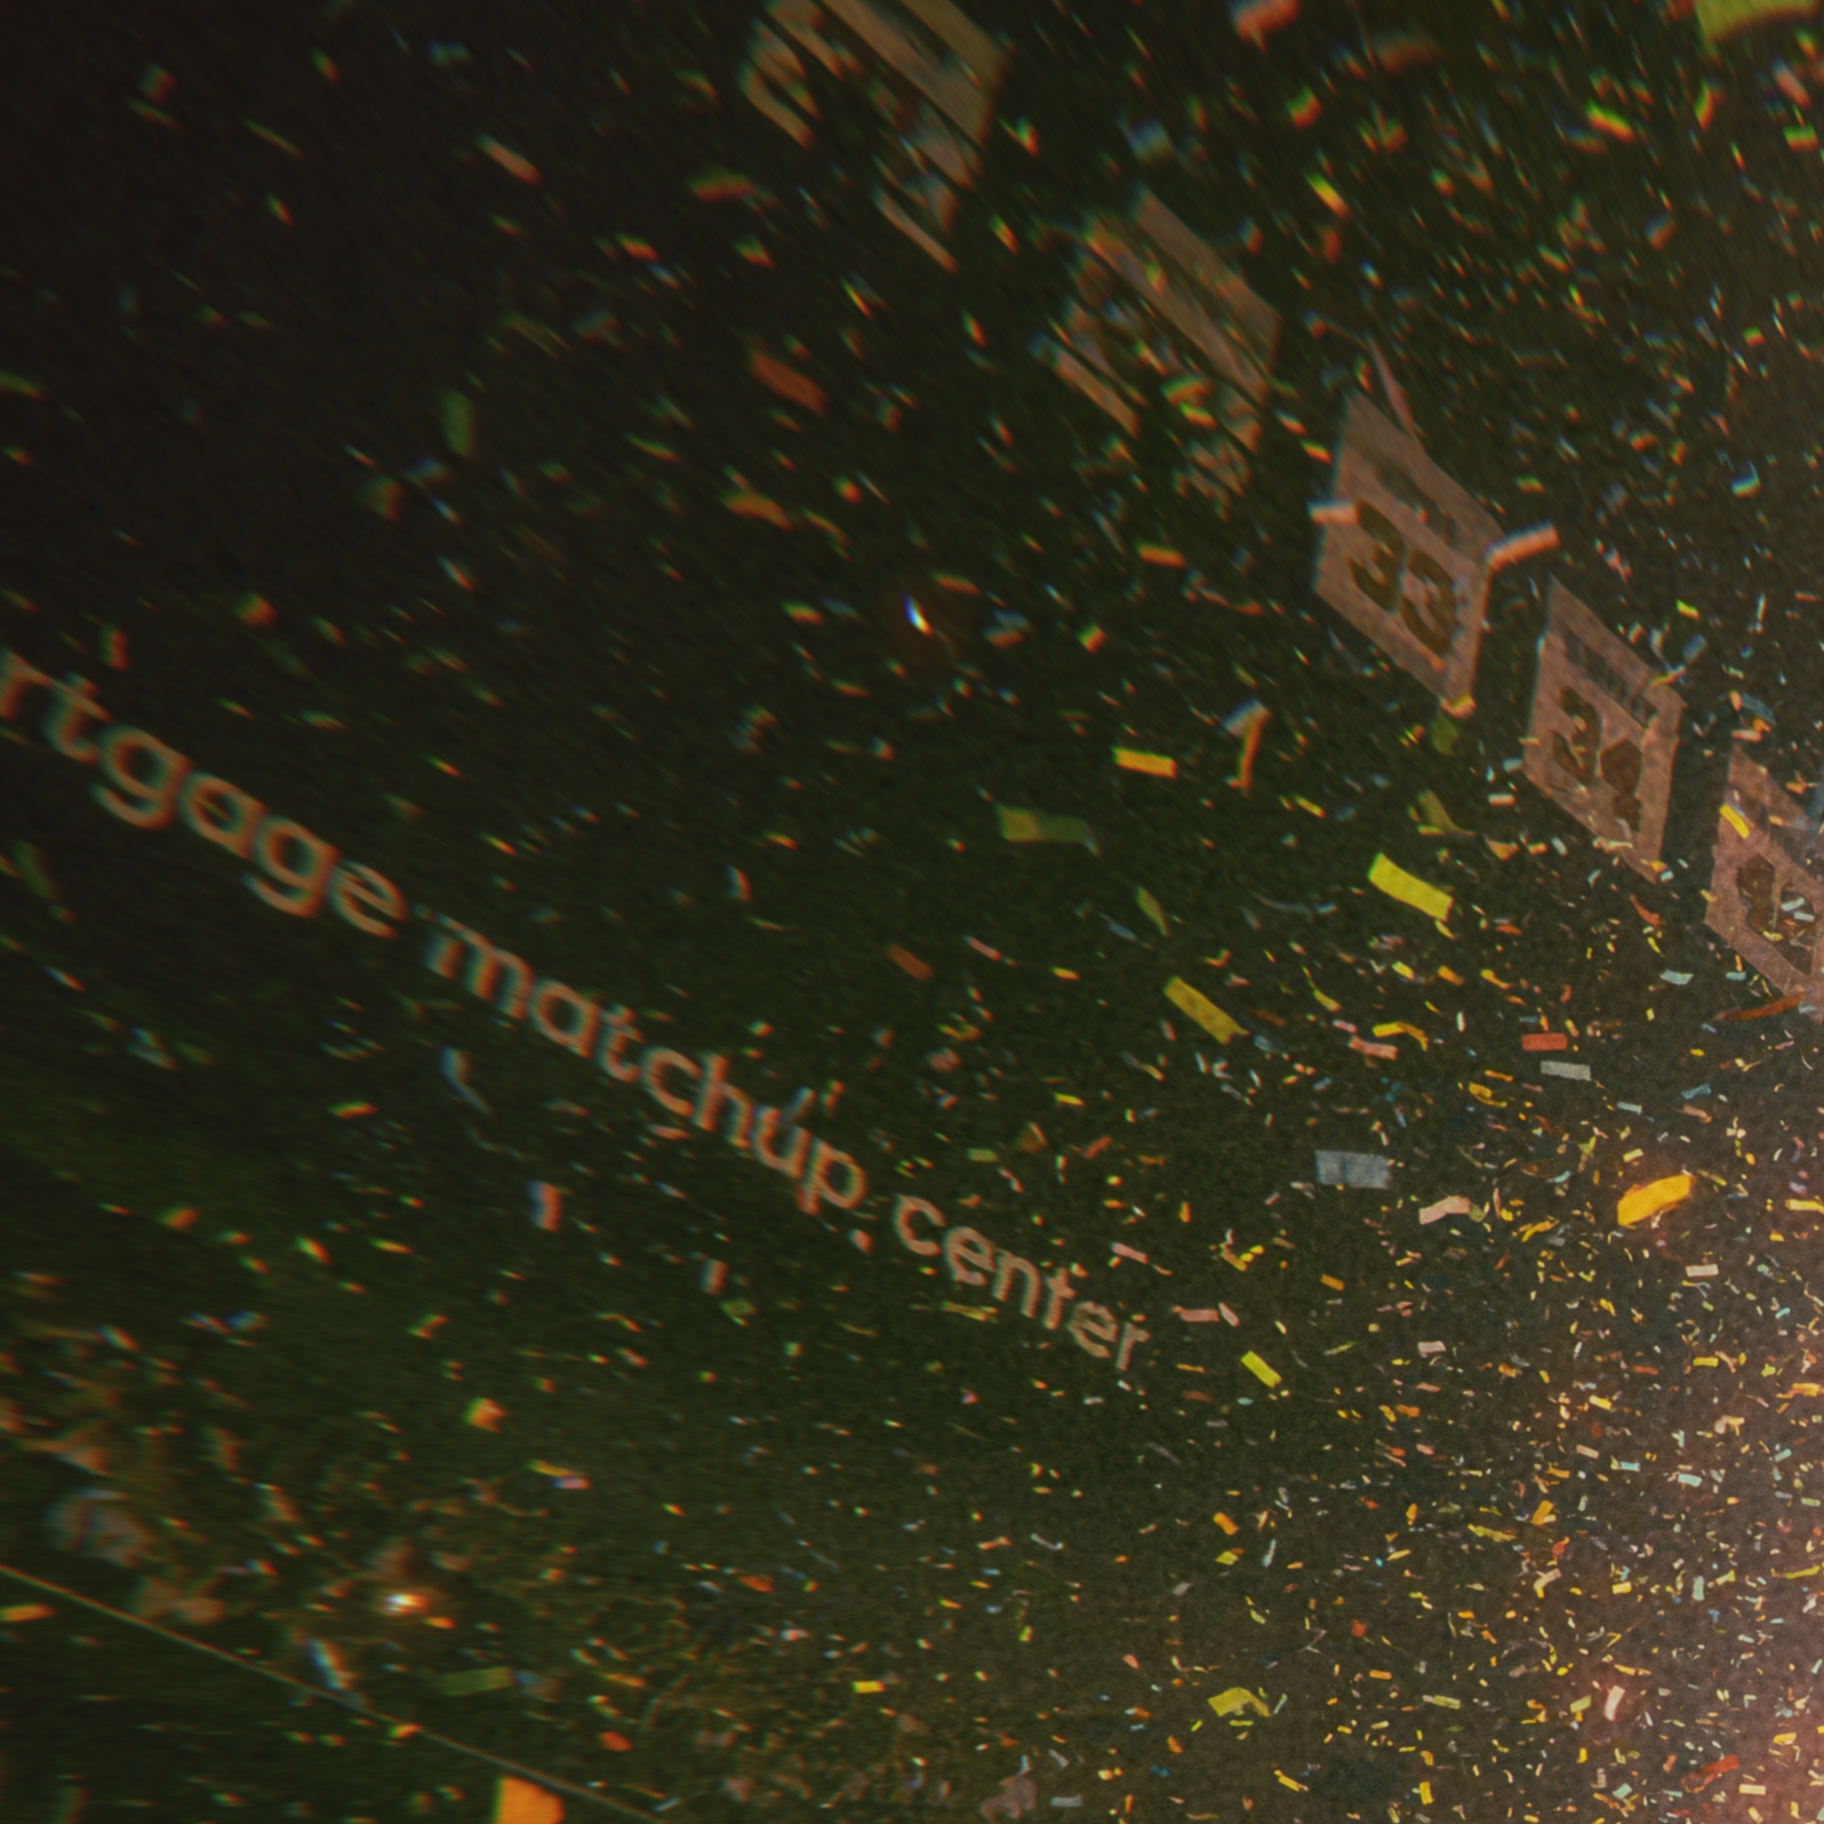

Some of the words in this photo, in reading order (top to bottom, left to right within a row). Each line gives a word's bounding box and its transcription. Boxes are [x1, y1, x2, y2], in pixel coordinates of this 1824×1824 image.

[1350, 500, 1457, 656] 33
[1549, 685, 1643, 832] 34
[424, 912, 867, 1214] matchup
[894, 1194, 1150, 1371] center
